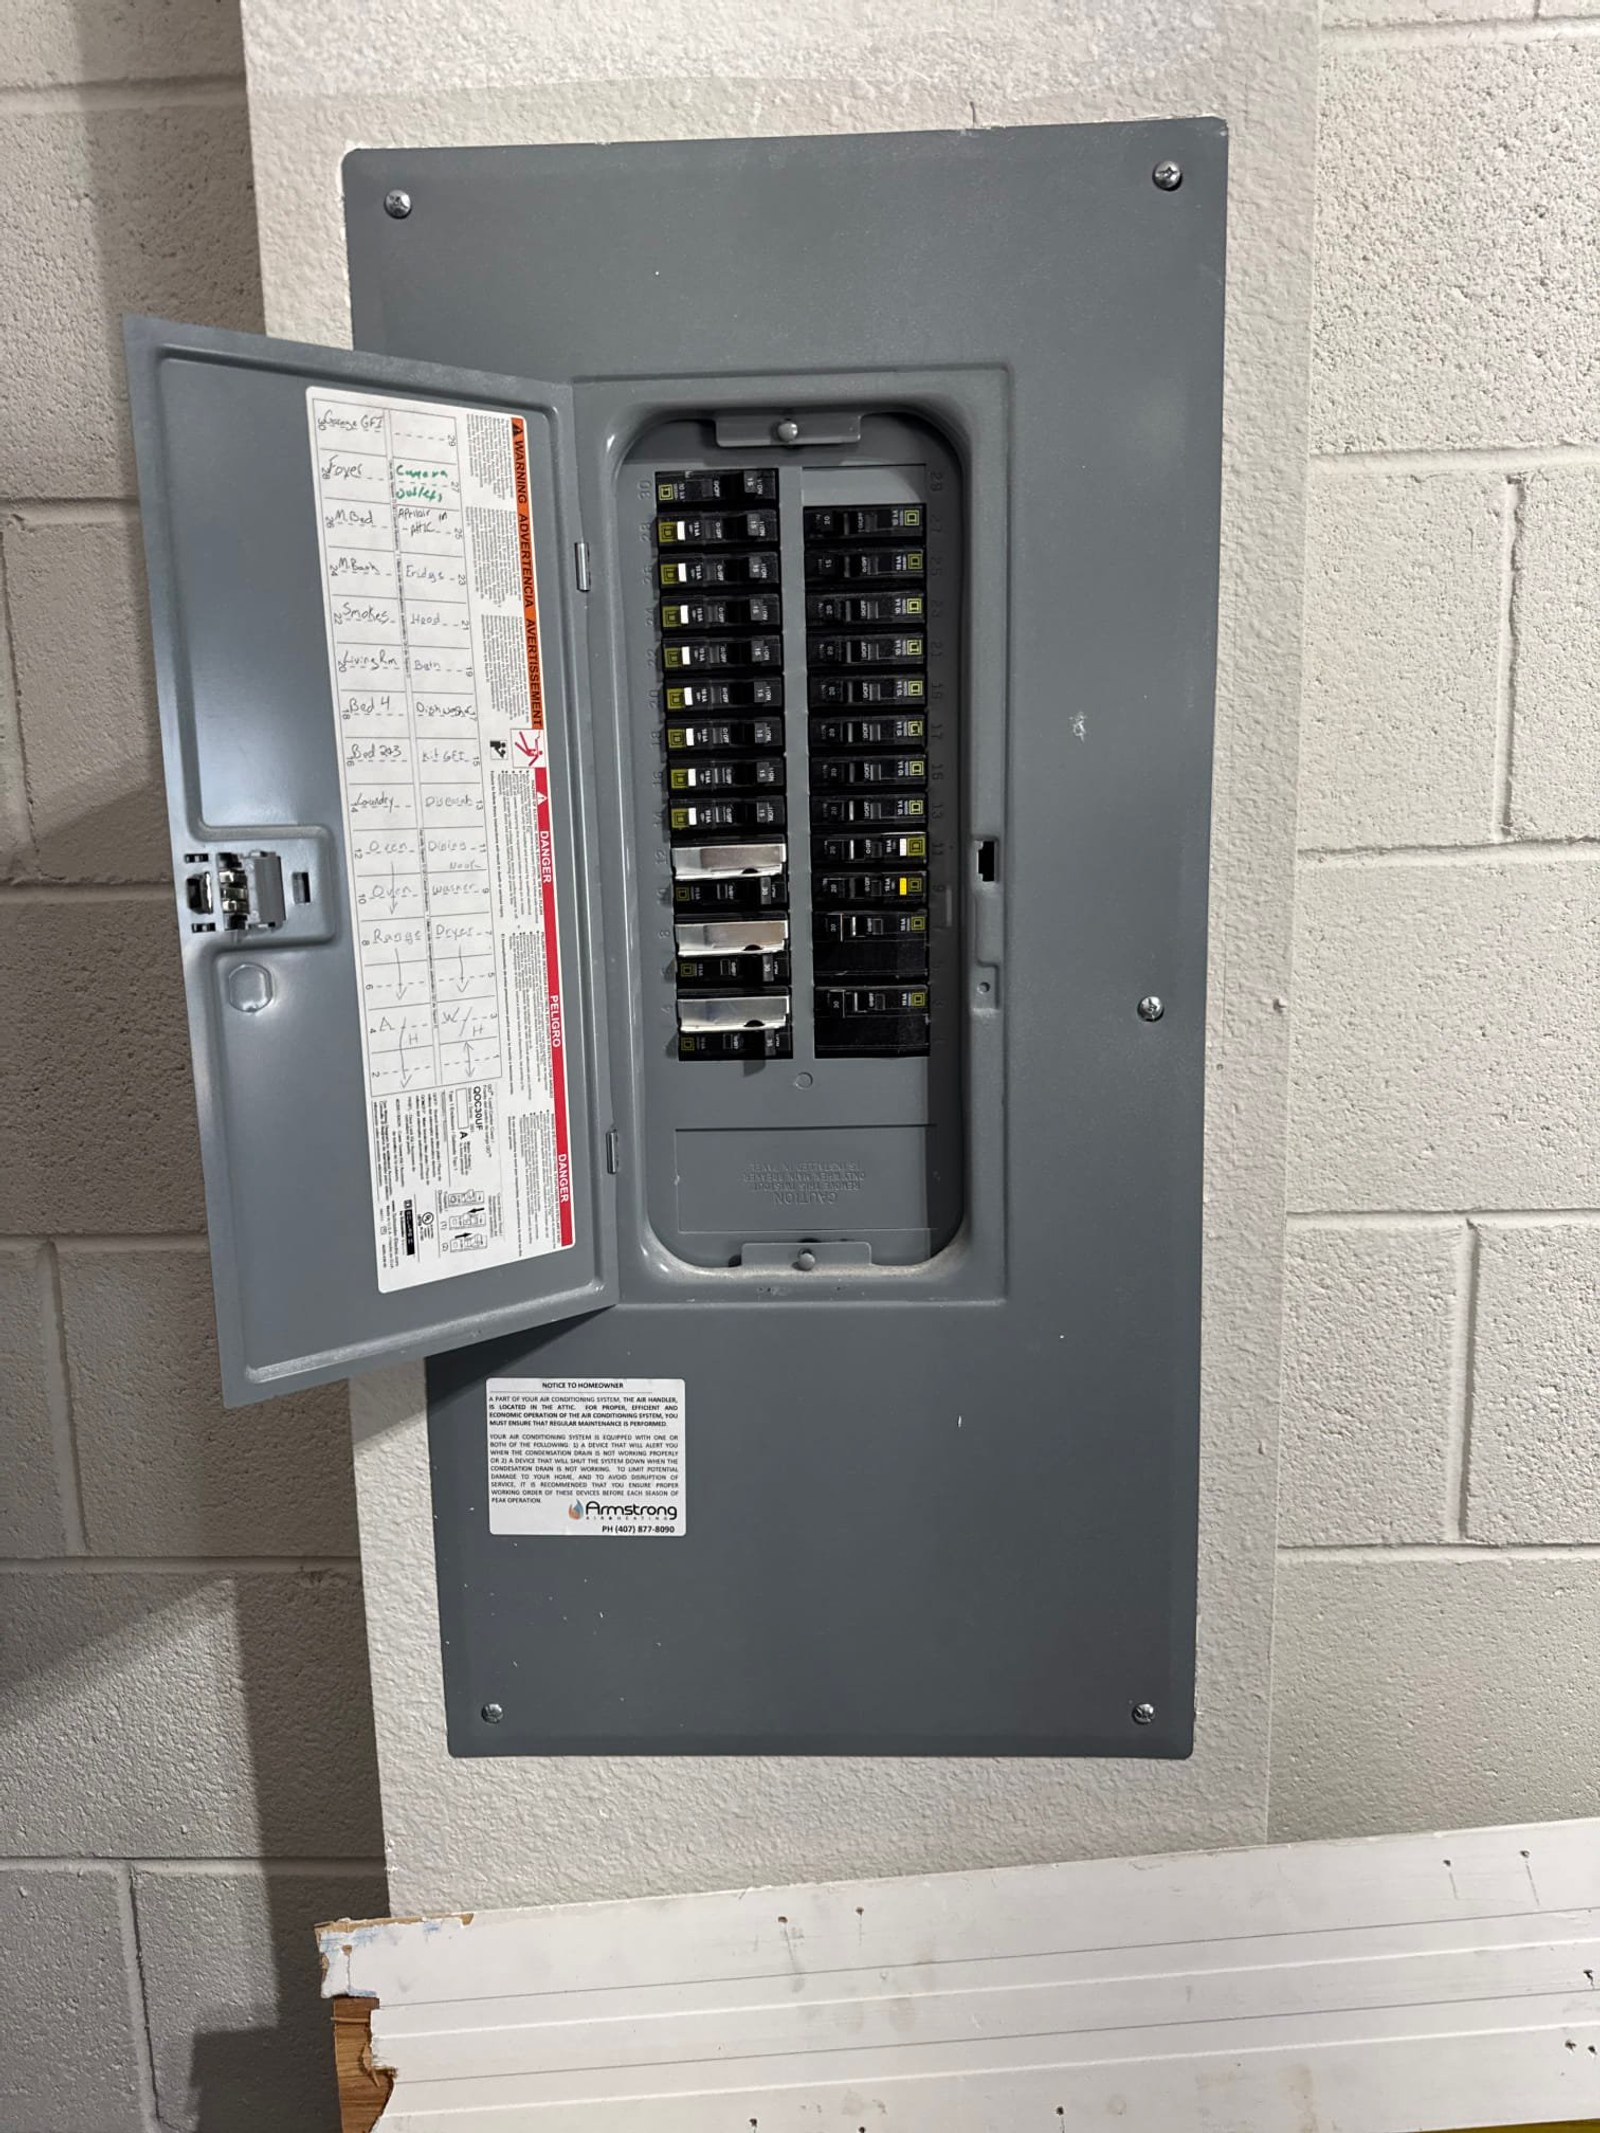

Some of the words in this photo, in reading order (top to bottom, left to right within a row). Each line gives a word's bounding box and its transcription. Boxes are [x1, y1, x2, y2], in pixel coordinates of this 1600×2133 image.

[360, 415, 383, 429] GFI
[448, 435, 456, 446] 29
[327, 455, 363, 480] Foyer
[516, 440, 528, 504] WARNING
[454, 528, 463, 539] 25
[518, 514, 535, 608] ADVERTENCIA
[458, 574, 466, 586] 23
[342, 602, 388, 624] Smokes
[344, 650, 379, 671] Living
[466, 668, 473, 677] 19
[526, 620, 542, 725] AVERTISSEMENT
[349, 698, 374, 713] Bed
[381, 696, 390, 710] 4
[342, 710, 350, 719] 18
[352, 744, 375, 758] Bed
[356, 792, 394, 813] Laundry
[355, 849, 363, 859] 12
[540, 830, 552, 883] DANGER
[358, 894, 366, 904] 10
[372, 885, 412, 898] Oven
[374, 929, 422, 944] Range
[436, 924, 474, 940] Dryer
[550, 994, 562, 1048] PELIGRO
[474, 1086, 484, 1130] QOC30UF
[459, 1131, 469, 1140] A
[558, 1154, 570, 1203] DANGER
[586, 1501, 677, 1520] Armstrong
